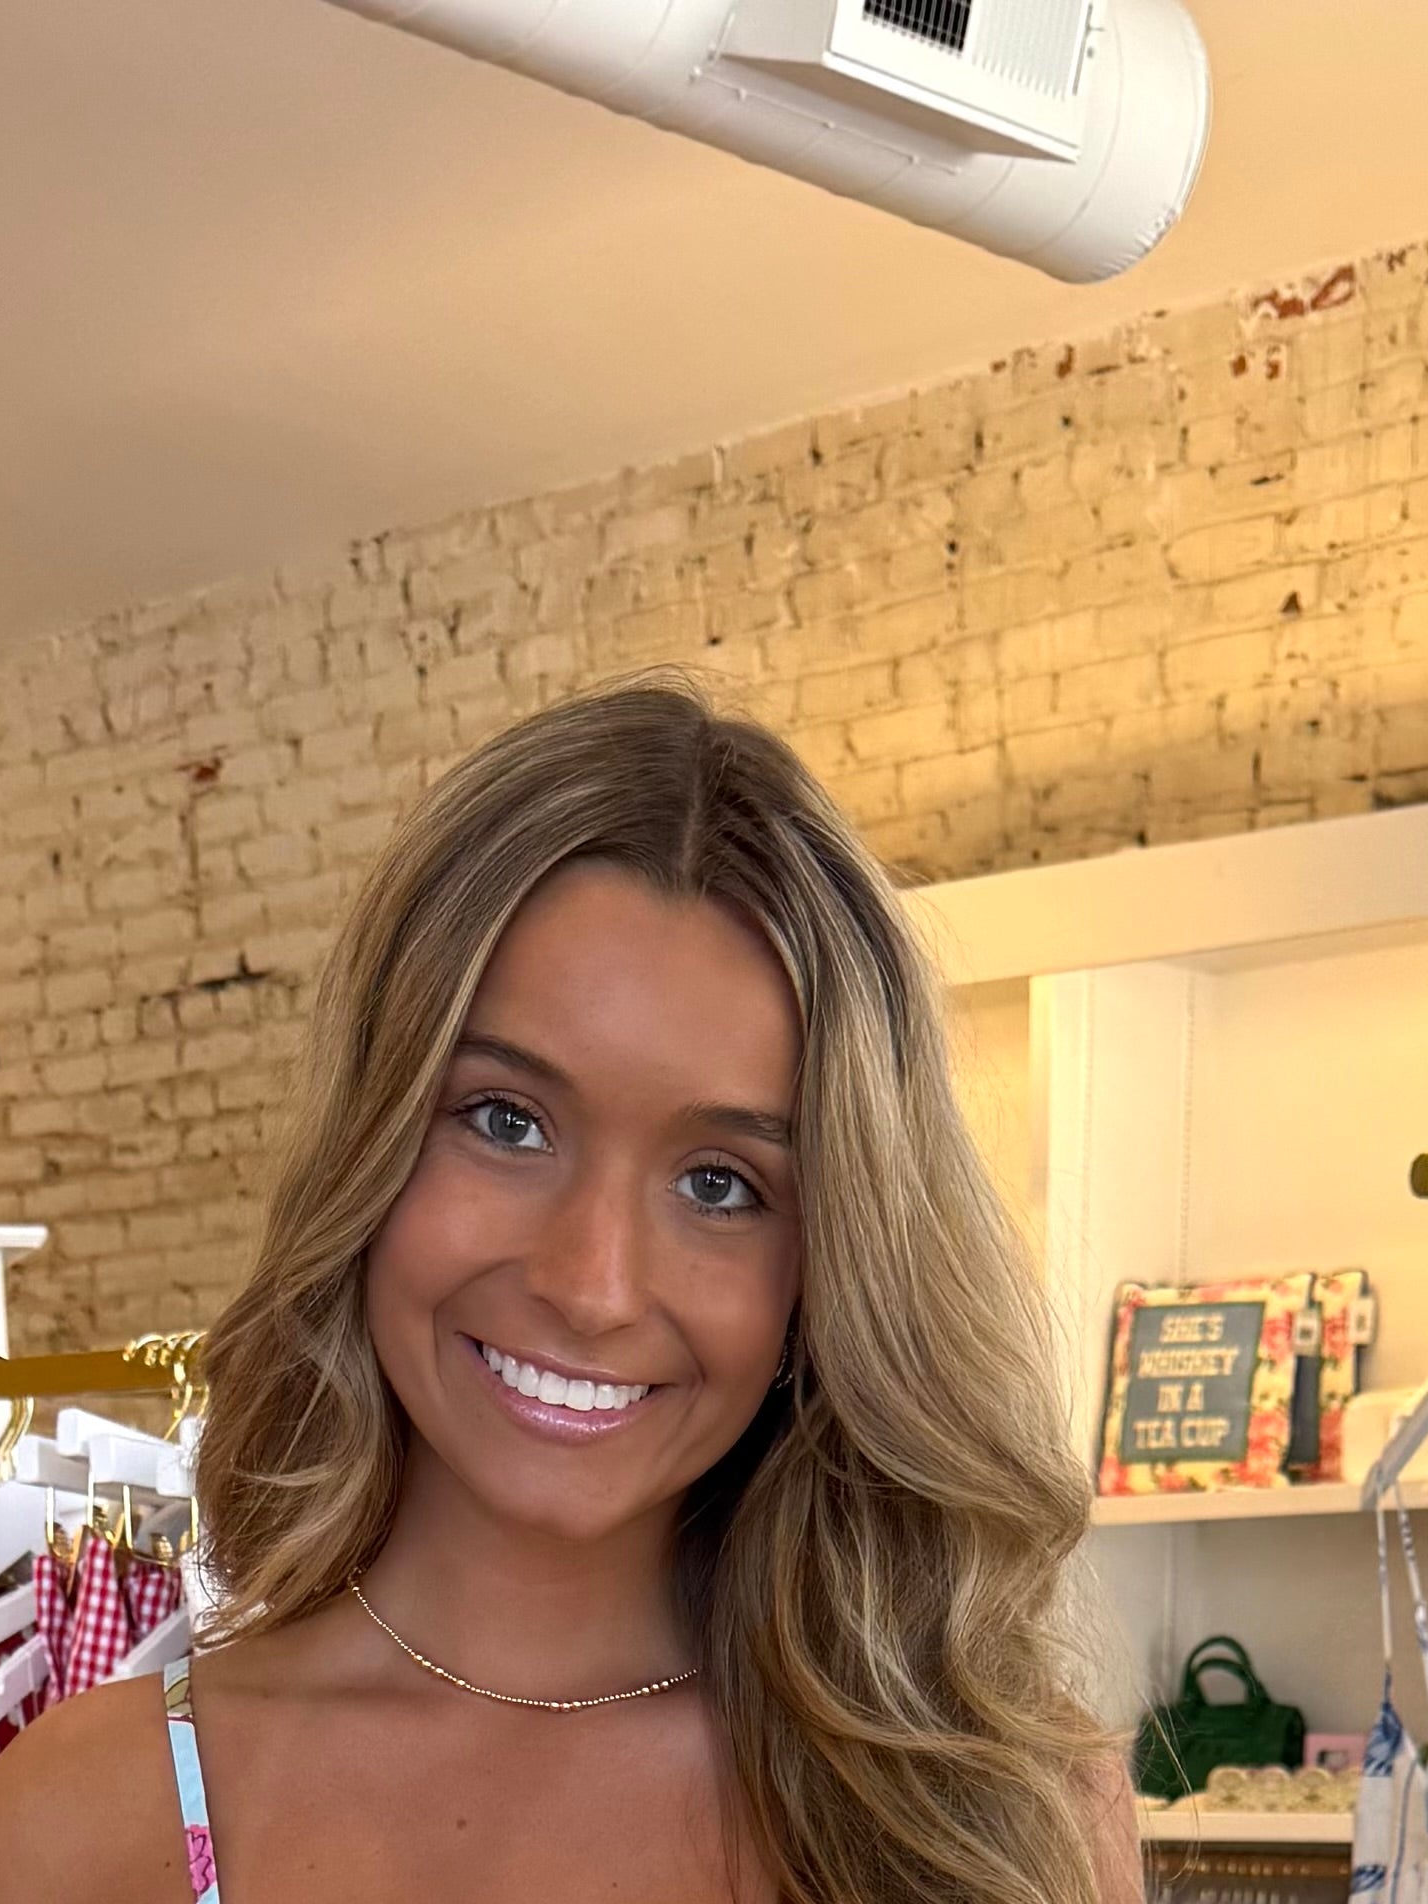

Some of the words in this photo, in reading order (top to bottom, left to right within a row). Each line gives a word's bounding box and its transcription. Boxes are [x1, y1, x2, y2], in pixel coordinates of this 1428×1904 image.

[1159, 1313, 1225, 1343] SHE'S
[1157, 1384, 1184, 1413] IN
[1186, 1383, 1204, 1412] A
[1133, 1418, 1177, 1449] TEA
[1180, 1416, 1230, 1447] CUP
